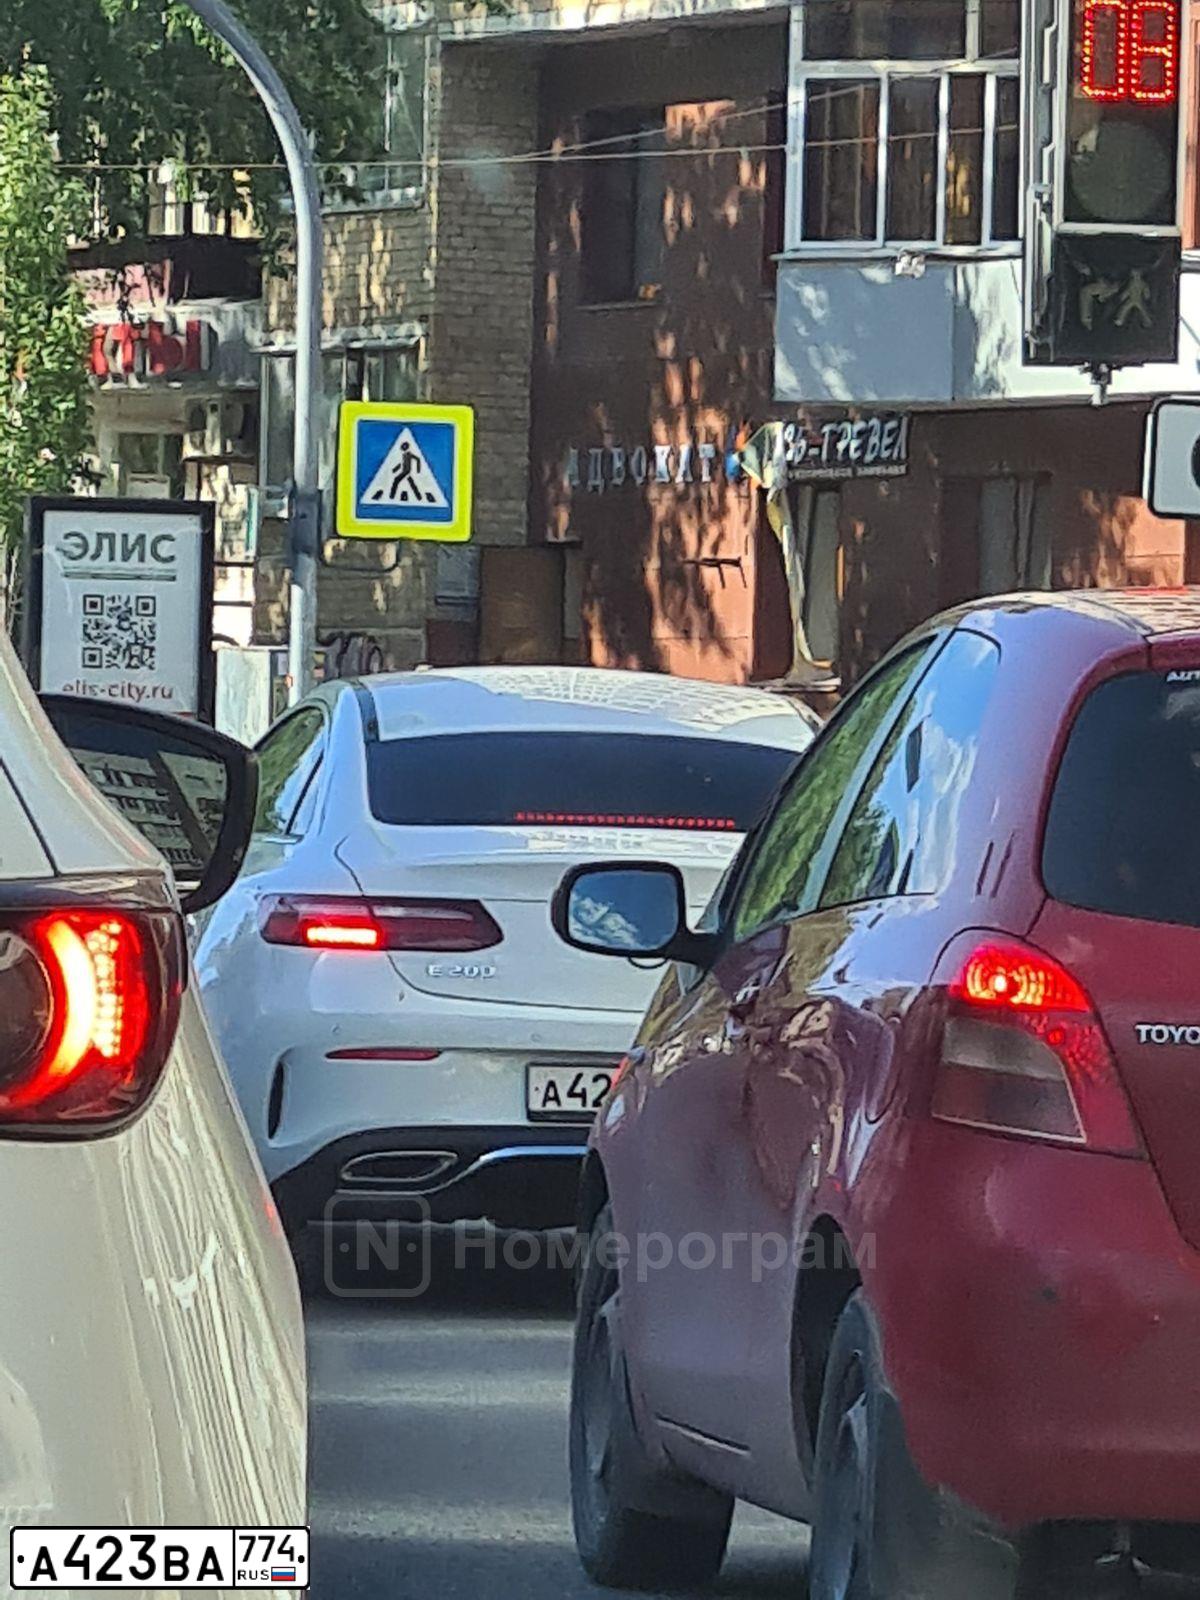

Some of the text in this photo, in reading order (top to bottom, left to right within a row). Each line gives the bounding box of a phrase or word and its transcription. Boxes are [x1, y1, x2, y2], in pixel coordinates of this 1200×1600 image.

[1083, 0, 1175, 99] 08
[565, 443, 715, 493] АДВОКАТ
[56, 531, 176, 563] ЭЛИС
[427, 963, 497, 980] E 200
[1134, 1024, 1200, 1045] TOYO
